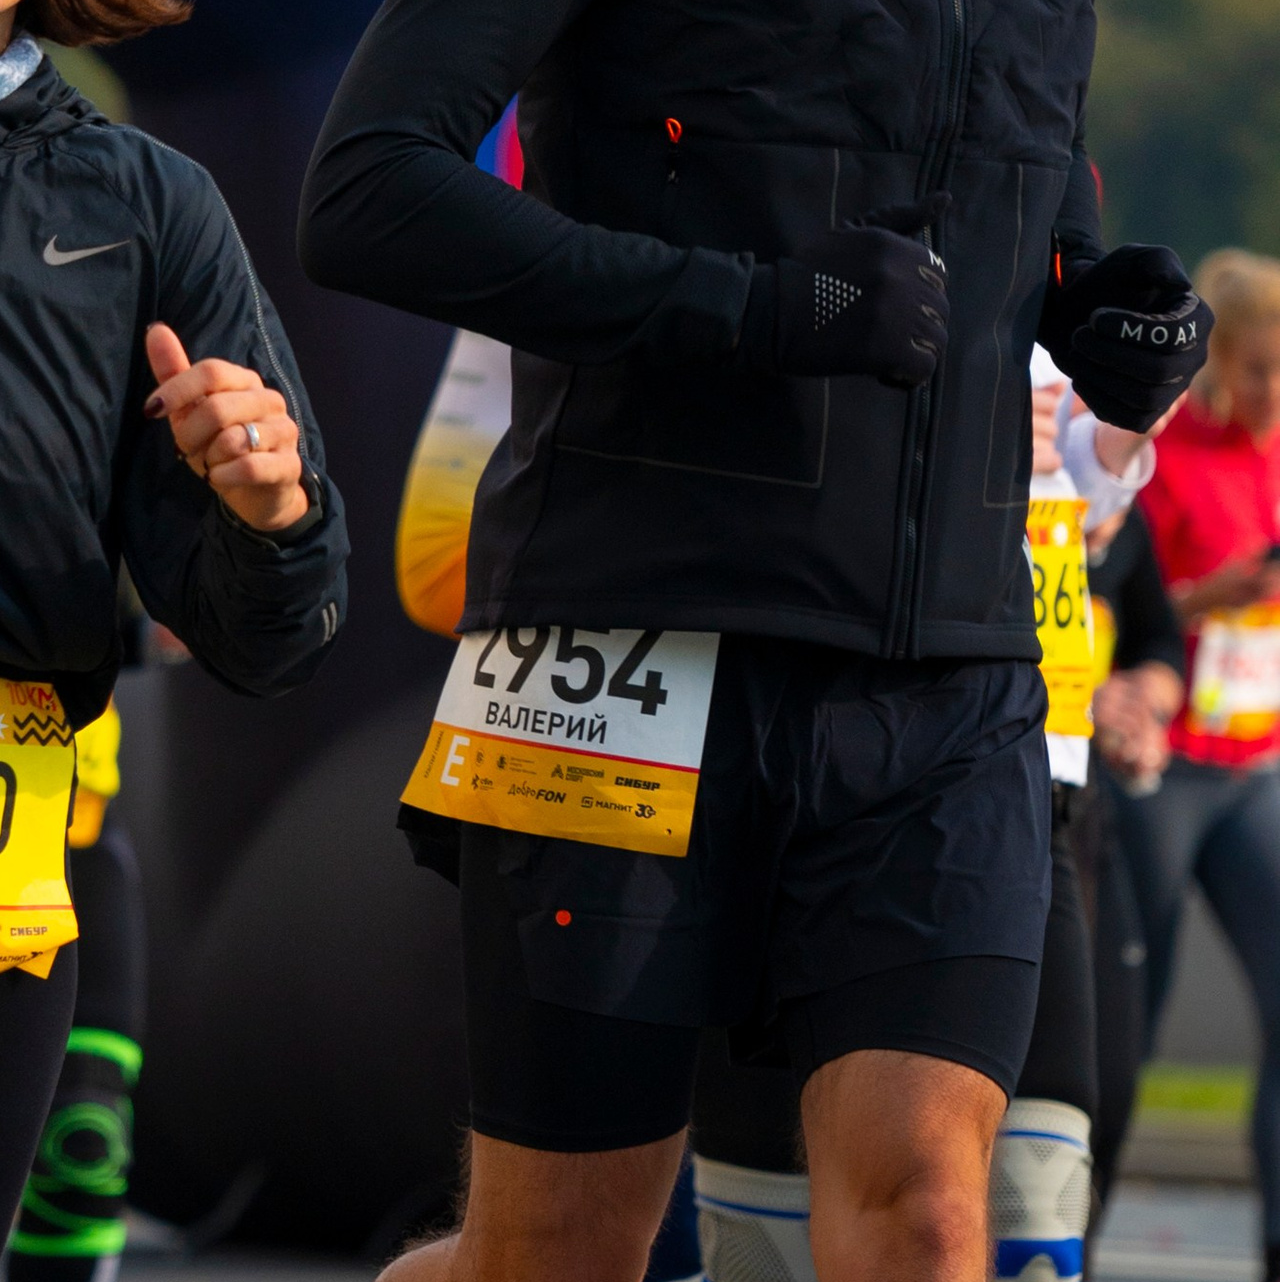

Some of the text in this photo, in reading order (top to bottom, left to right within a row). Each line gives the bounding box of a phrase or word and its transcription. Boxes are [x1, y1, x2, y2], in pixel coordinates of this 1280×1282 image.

[1120, 320, 1197, 346] MOAX
[472, 625, 669, 717] 2954
[485, 700, 608, 744] ВАЛЕРИЙ
[440, 734, 471, 787] E
[614, 776, 661, 792] СИБУР
[595, 800, 633, 813] МАГНИТ
